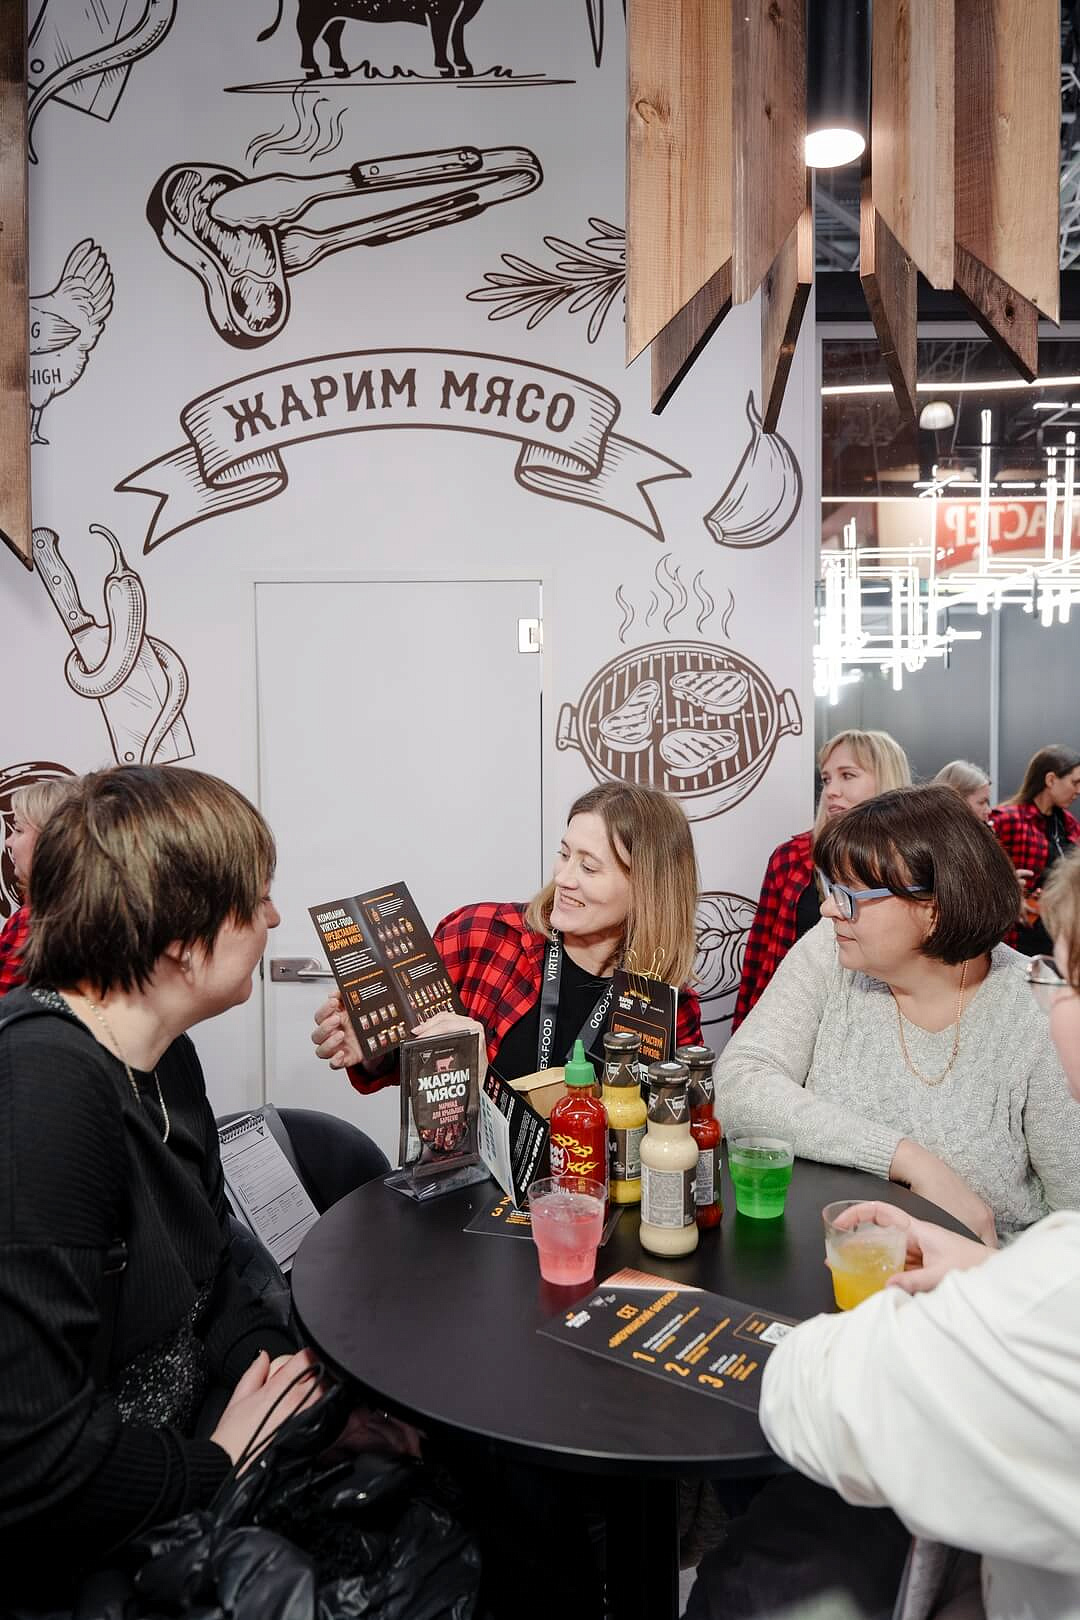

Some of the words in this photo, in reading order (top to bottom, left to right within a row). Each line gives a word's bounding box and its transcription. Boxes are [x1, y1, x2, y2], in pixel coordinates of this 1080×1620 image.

[30, 368, 61, 384] HIGH
[223, 368, 417, 442] ЖАРИМ
[440, 370, 576, 433] МЯСО
[320, 916, 354, 933] VIRTEX-FOOD
[327, 937, 350, 951] ЖАРИМ
[347, 933, 363, 946] МЯСО
[547, 927, 560, 981] VIRTEX-FO
[590, 984, 614, 1029] X-FOOD
[540, 1018, 553, 1070] EX-FOOD
[417, 1068, 470, 1091] ЖАРИМ
[426, 1083, 466, 1103] МЯСО
[491, 1207, 504, 1217] 3
[632, 1351, 656, 1363] 1
[664, 1362, 690, 1377] 2
[698, 1374, 725, 1388] 3
